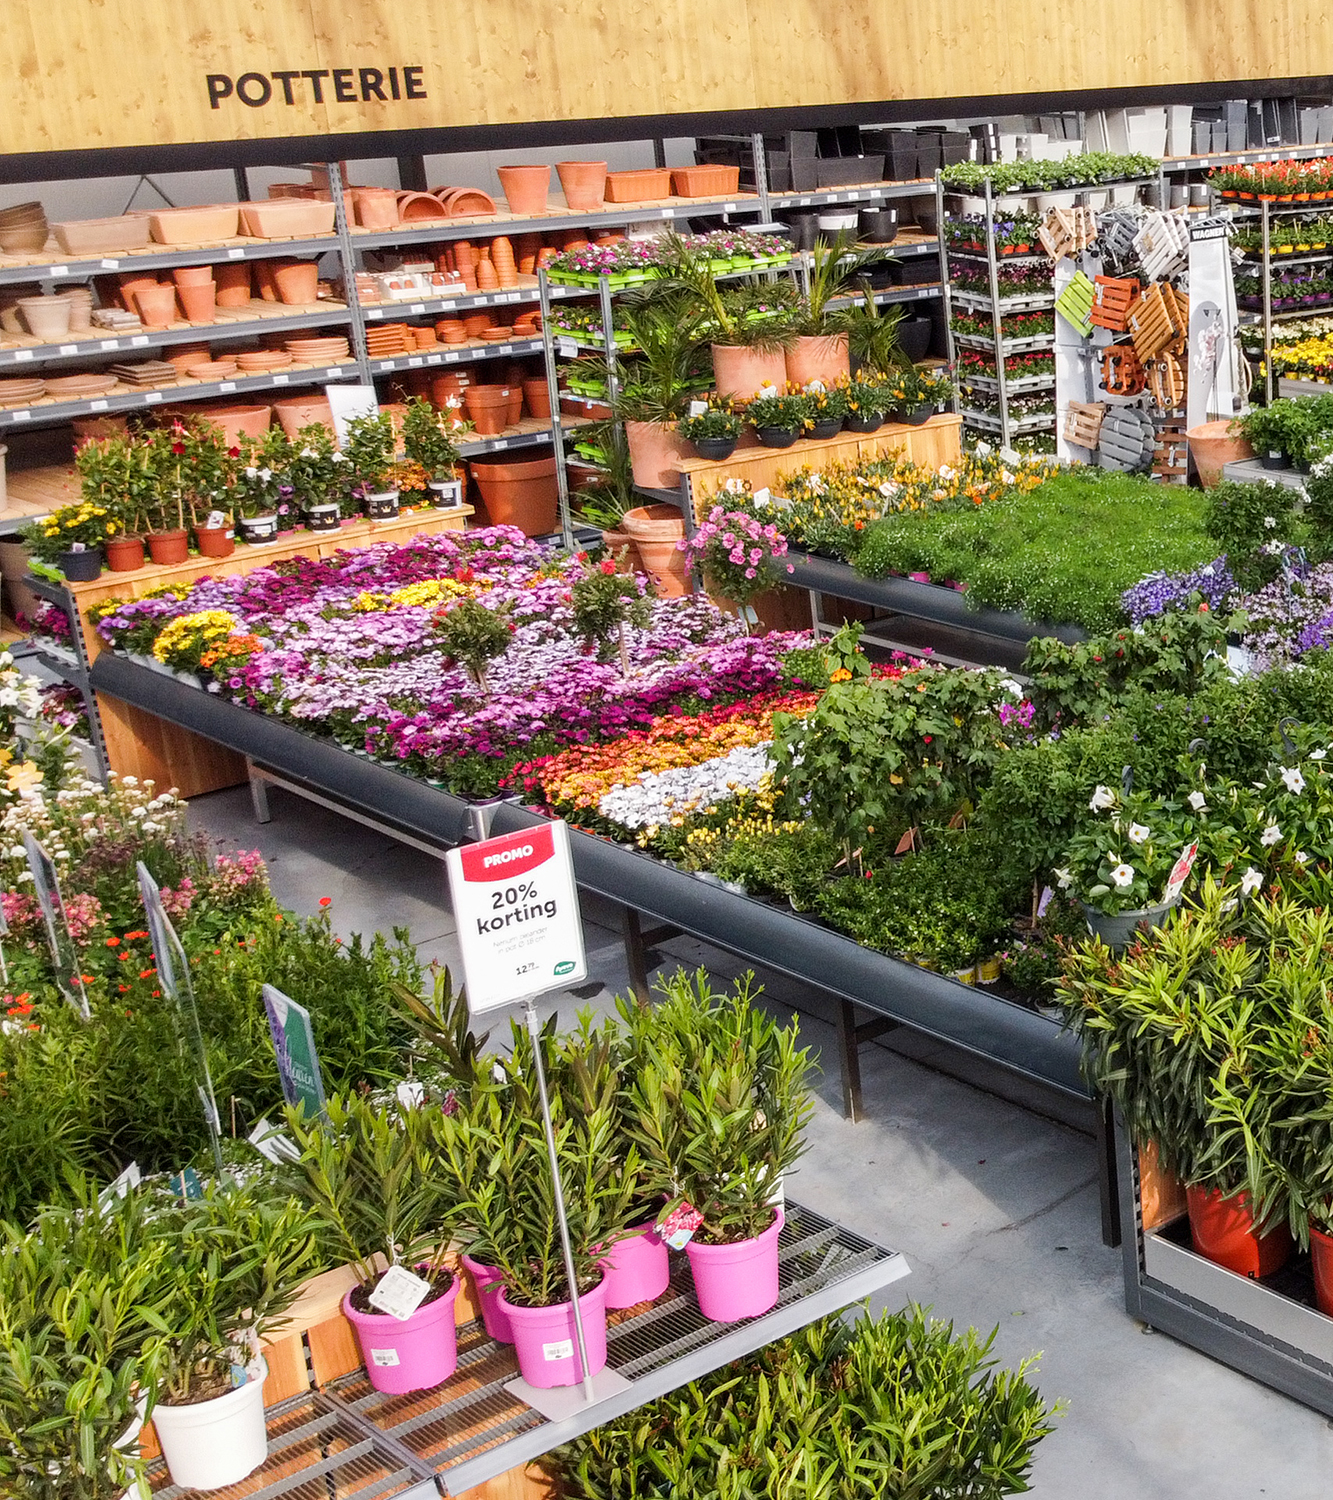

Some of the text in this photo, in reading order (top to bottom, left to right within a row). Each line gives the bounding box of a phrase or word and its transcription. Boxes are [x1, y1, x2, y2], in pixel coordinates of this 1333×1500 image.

[206, 66, 428, 109] POTTERIE
[1192, 227, 1224, 240] WAGNER
[483, 845, 534, 868] PROMO
[491, 880, 538, 910] 20%
[476, 899, 558, 935] korting
